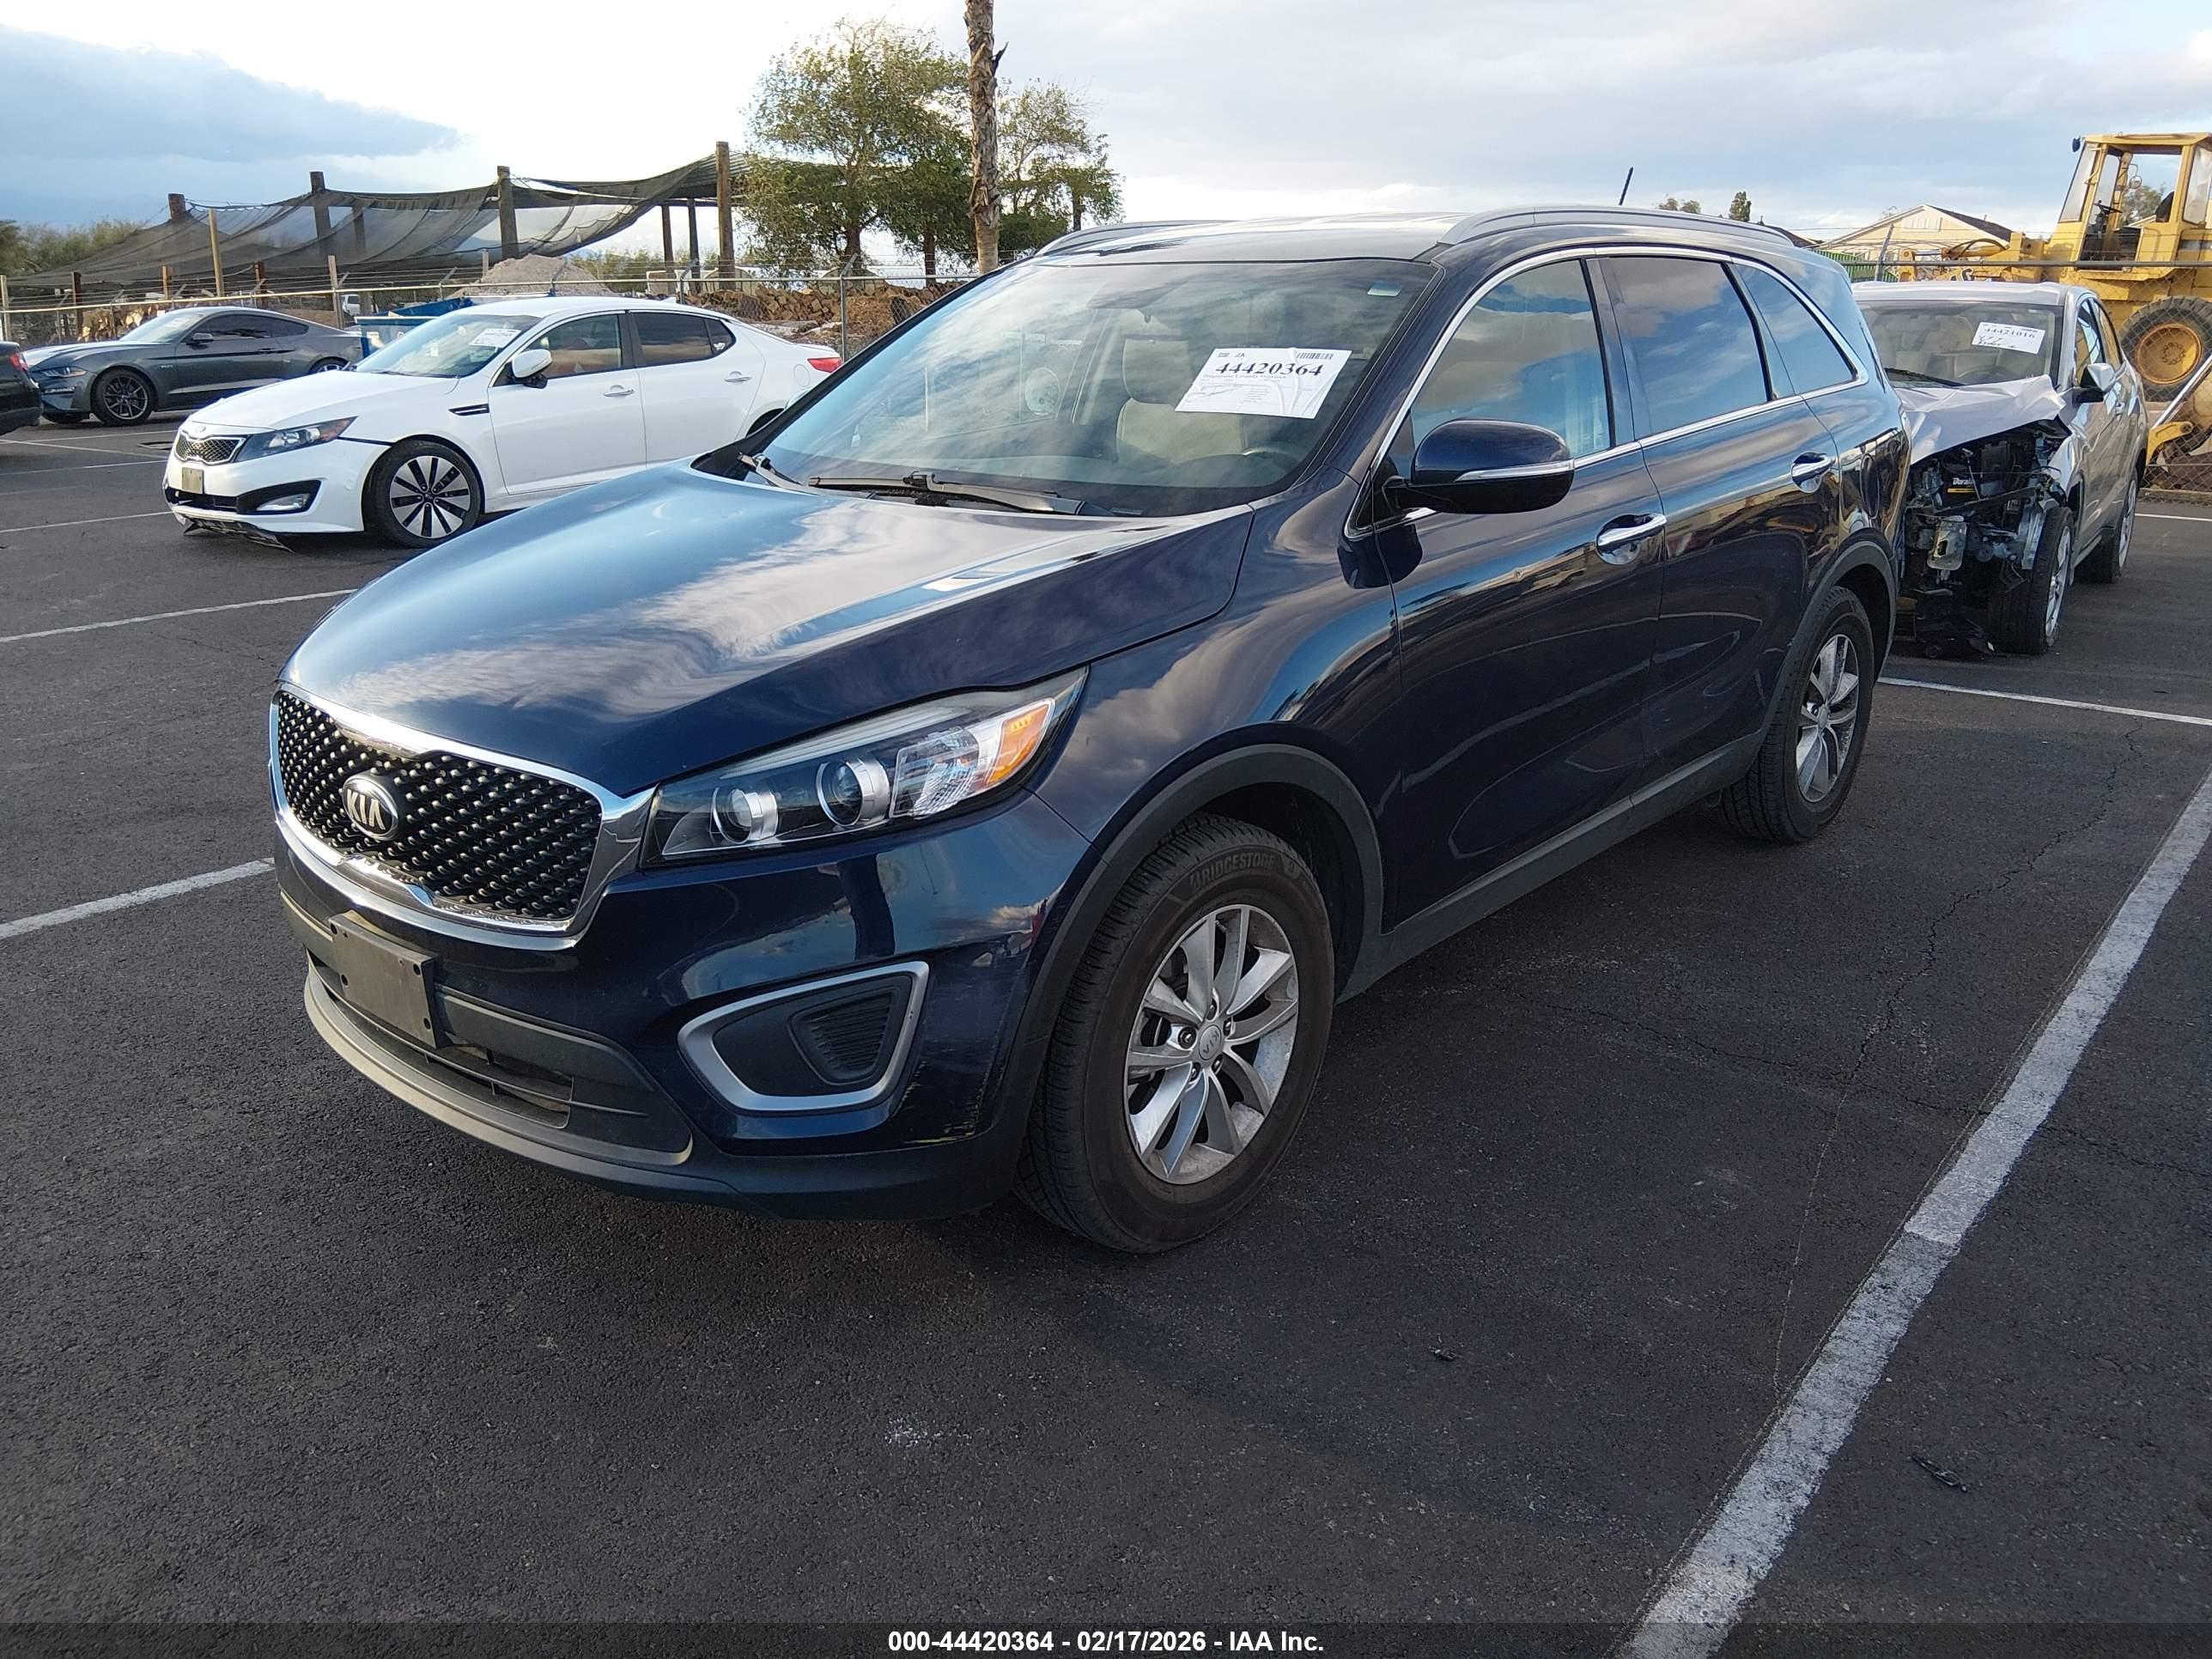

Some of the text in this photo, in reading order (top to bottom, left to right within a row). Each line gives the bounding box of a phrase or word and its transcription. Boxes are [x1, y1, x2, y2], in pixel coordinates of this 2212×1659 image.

[1215, 362, 1323, 376] 44420364
[347, 788, 386, 830] KIA
[1189, 852, 1276, 890] BRIDGESTONE
